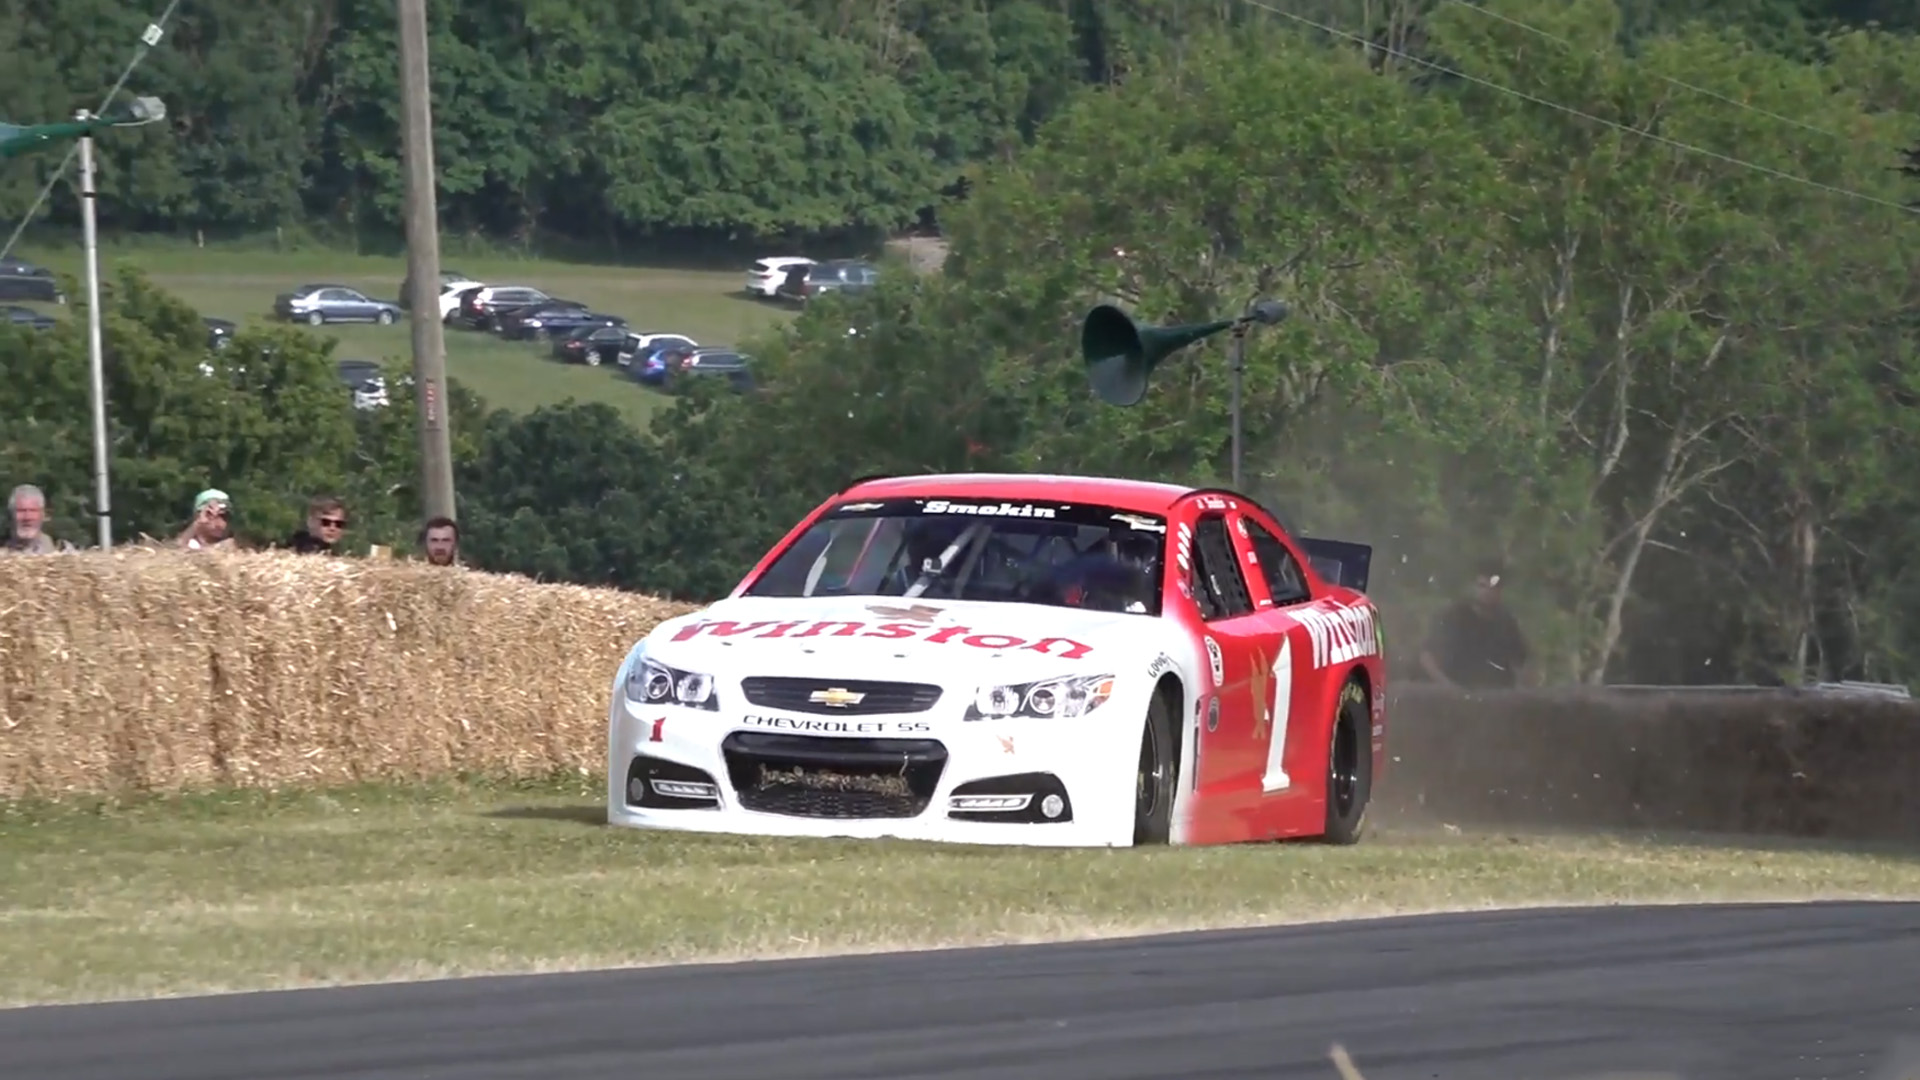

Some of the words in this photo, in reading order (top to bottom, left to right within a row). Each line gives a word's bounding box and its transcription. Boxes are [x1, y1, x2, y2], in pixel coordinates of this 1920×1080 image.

[669, 618, 1094, 660] Winston
[743, 715, 887, 733] CHEVROLET
[897, 722, 931, 732] SS
[1262, 632, 1292, 792] 1
[649, 717, 666, 742] 1
